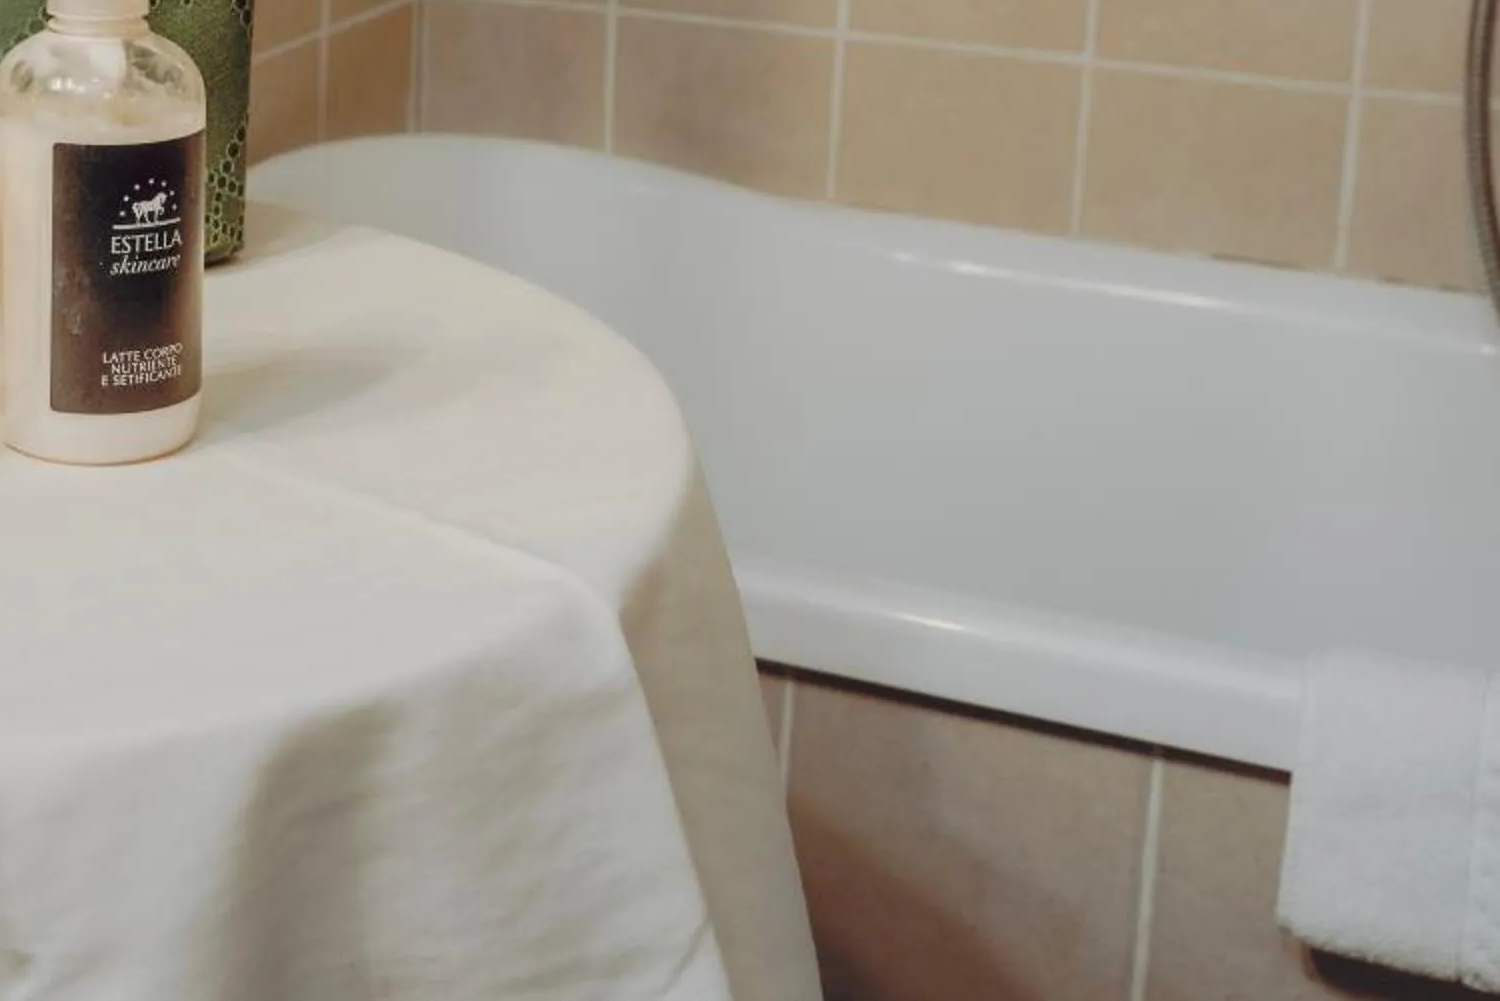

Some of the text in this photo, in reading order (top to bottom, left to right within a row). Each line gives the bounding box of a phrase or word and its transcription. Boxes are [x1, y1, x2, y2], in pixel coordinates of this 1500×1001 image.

[111, 229, 182, 254] ESTELLA
[103, 343, 183, 364] LATTE CORPO
[101, 375, 108, 386] E
